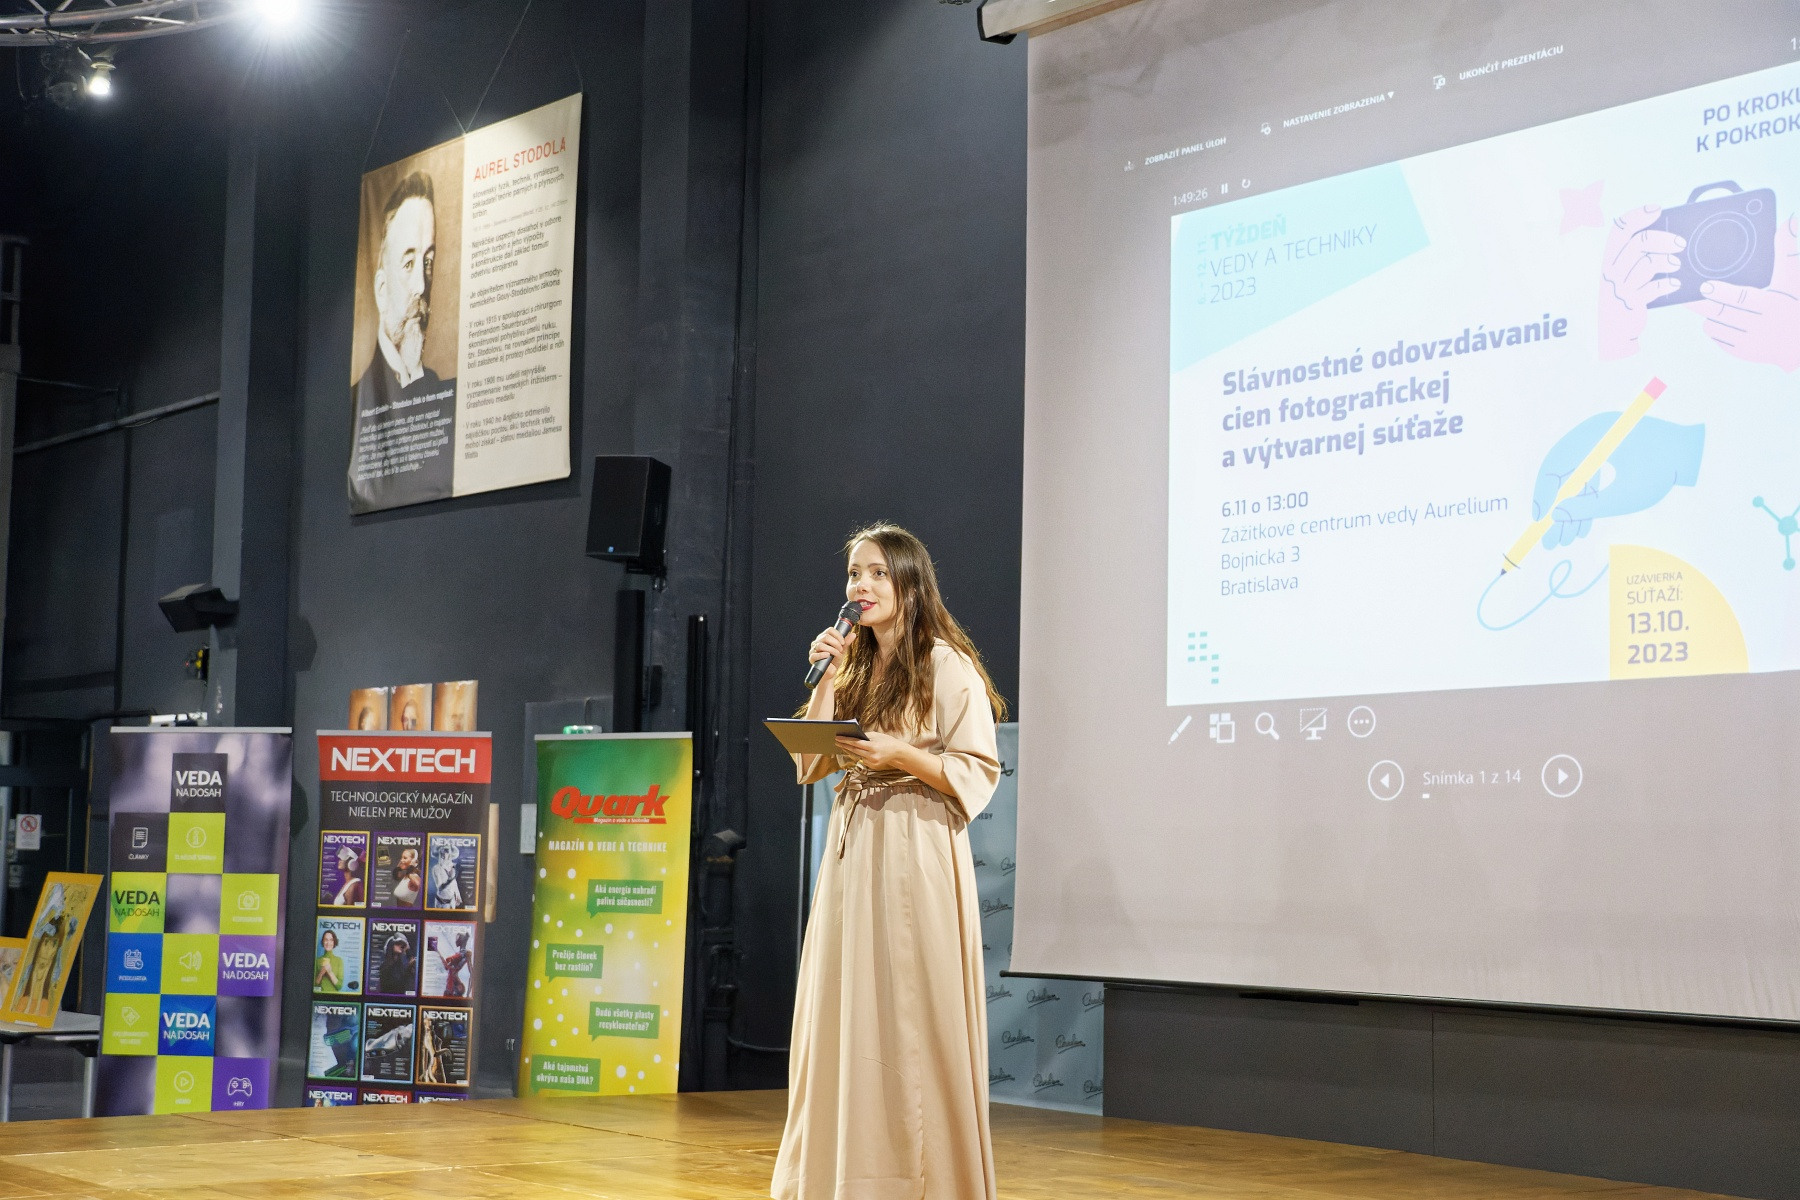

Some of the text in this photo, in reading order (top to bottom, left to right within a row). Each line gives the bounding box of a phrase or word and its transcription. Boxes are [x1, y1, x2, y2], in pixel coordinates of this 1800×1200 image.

[1459, 45, 1564, 80] UKONČIŤ PREZENTÁCIU
[1283, 94, 1386, 128] NASTAVENIE ZOBRAZENIA
[1703, 104, 1731, 126] PO
[1697, 113, 1800, 153] K POKROK
[474, 137, 566, 181] AUREL STODOLA
[1144, 147, 1180, 166] ZOBRAZIŤ
[1181, 143, 1204, 156] PANEL
[1173, 188, 1208, 206] 1:49:26
[1211, 213, 1287, 250] TÝŽDEŇ
[1210, 223, 1377, 277] VEDY A TECHNIKY
[1210, 277, 1257, 304] 2023
[1222, 312, 1568, 396] Slávnostné odovzdávanie
[1222, 370, 1450, 432] cien fotografickej
[1222, 410, 1464, 470] a výtvarnej súťaže
[1221, 491, 1309, 517] 6.11 o 13:00
[1300, 511, 1372, 535] centrum
[1377, 504, 1418, 526] vedy
[1424, 496, 1509, 520] Aurelium
[1290, 546, 1301, 563] 3
[1221, 575, 1299, 597] Bratislava
[1627, 610, 1690, 634] 13.10.
[1627, 641, 1689, 664] 2023
[331, 747, 476, 773] NEXTECH
[175, 770, 223, 786] VEDA
[1423, 769, 1522, 786] Snímka 1 z 14
[190, 788, 222, 798] DOSAH
[330, 790, 473, 805] TECHNOLOGICKÝ MAGAZÍN
[550, 784, 671, 819] Quark
[349, 805, 452, 820] NIELEN PRE MUŽOV
[323, 835, 365, 844] NEXTECH
[377, 836, 421, 846] NEXTECH
[431, 837, 476, 847] NEXTECH
[548, 838, 667, 853] MAGAZÍN O VEDE A TECHNIKE
[113, 890, 160, 905] VEDA
[319, 921, 361, 930] NEXTECH
[372, 922, 416, 933] NEXTECH
[222, 952, 270, 968] VEDA
[576, 950, 598, 960] človek
[237, 970, 269, 981] DOSAH
[314, 1005, 357, 1015] NEXTECH
[368, 1007, 412, 1018] NEXTECH
[423, 1010, 468, 1021] NEXTECH
[163, 1012, 211, 1029] VEDA
[177, 1031, 210, 1041] DOSAH
[308, 1090, 353, 1100] NEXTECH
[363, 1092, 408, 1103] NEXTECH
